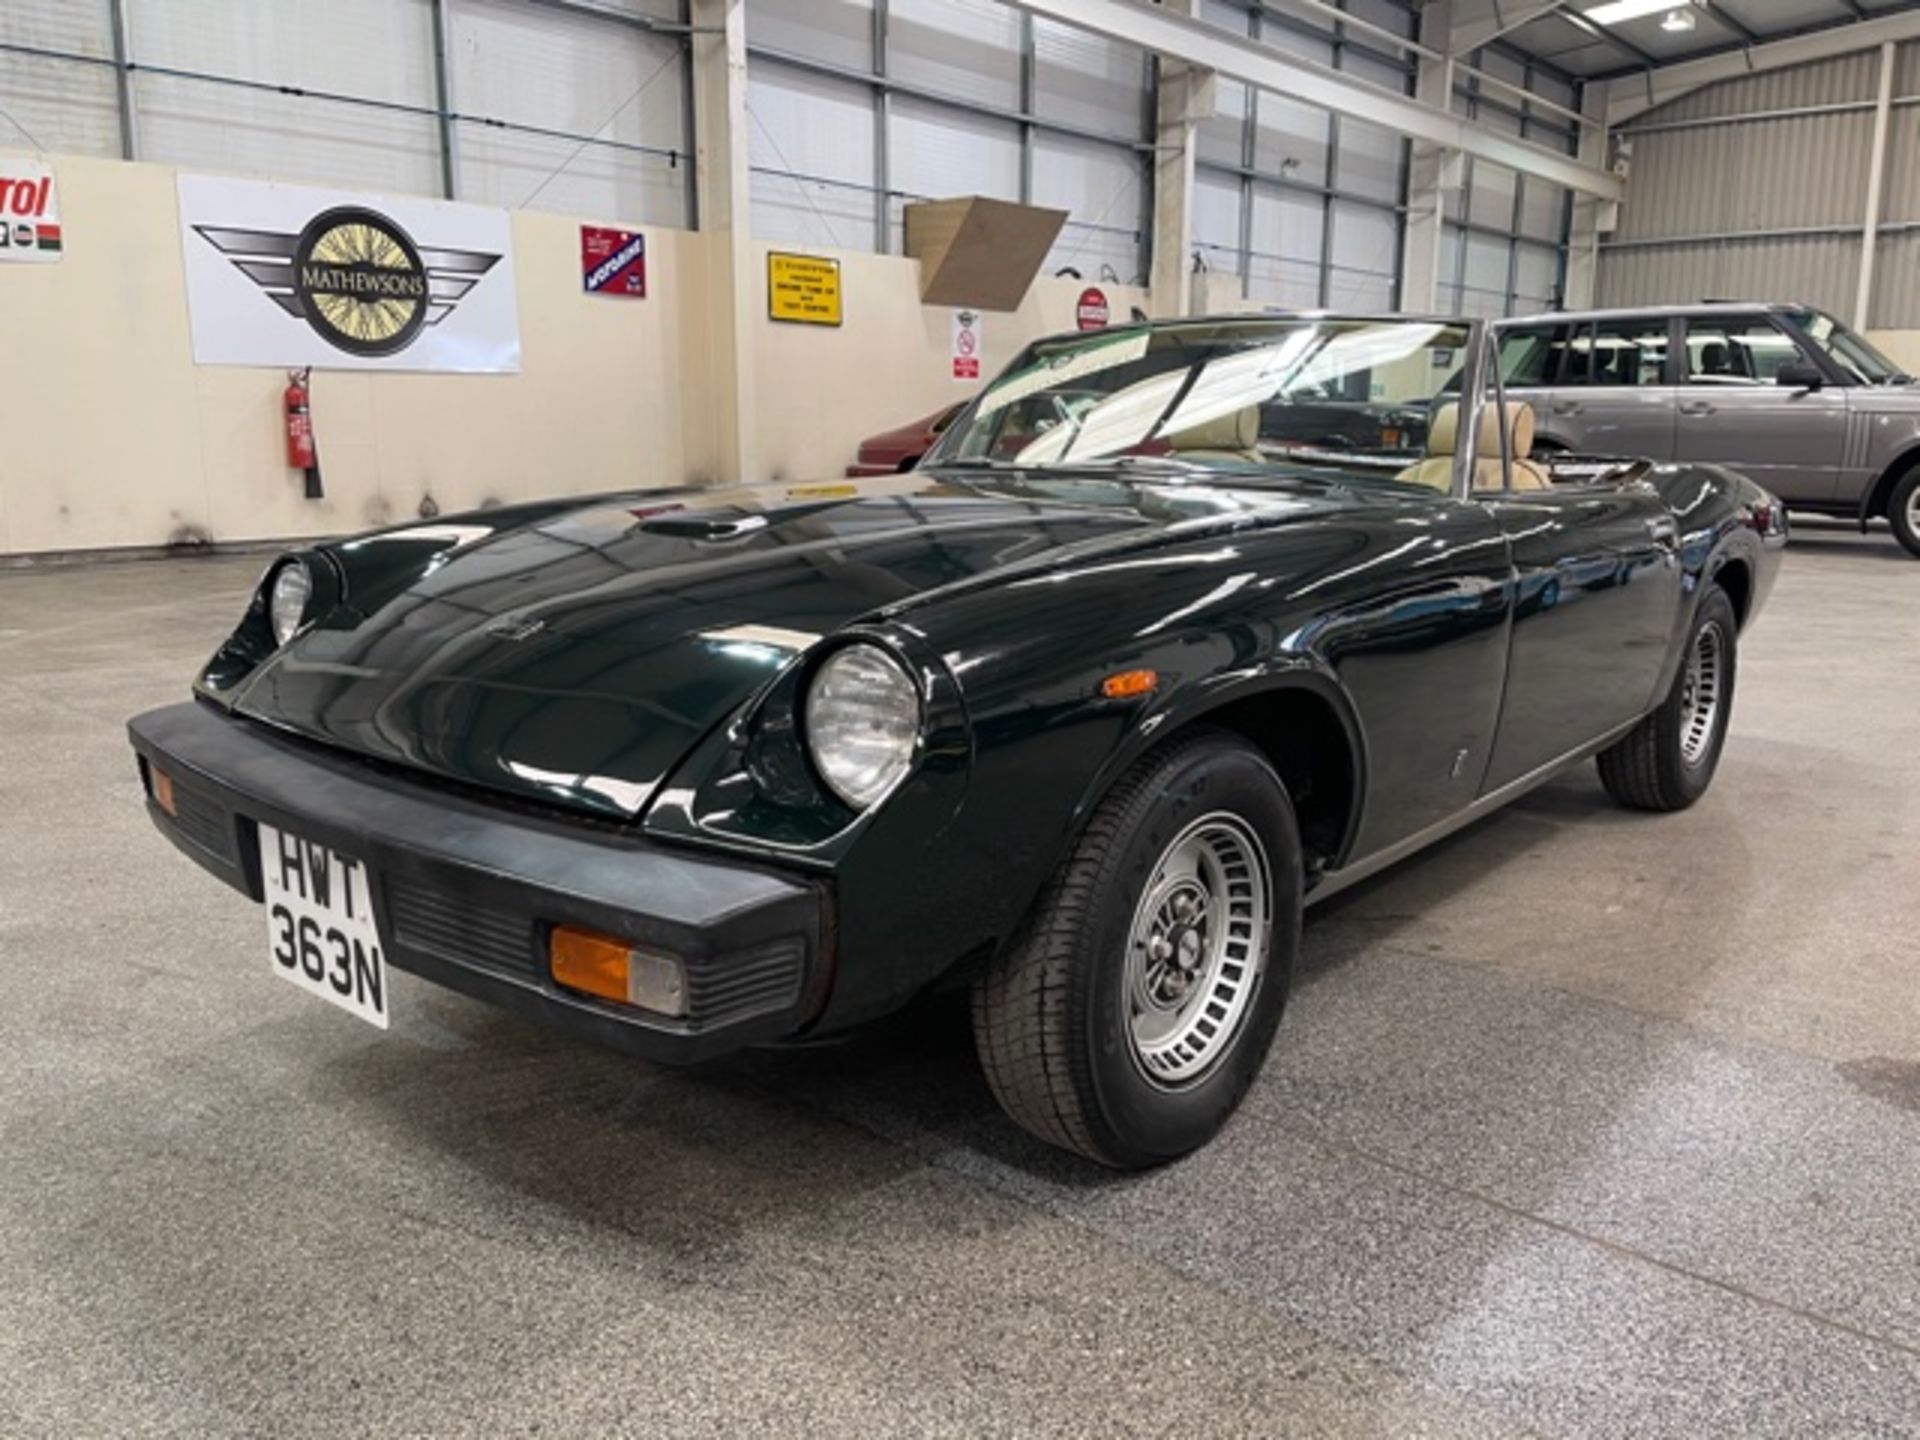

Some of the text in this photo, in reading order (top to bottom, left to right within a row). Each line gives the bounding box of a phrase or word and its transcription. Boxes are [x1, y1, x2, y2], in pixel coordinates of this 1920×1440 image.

[302, 265, 424, 295] MATHEWSONS
[280, 830, 359, 919] HWT
[272, 904, 382, 1014] 363N
